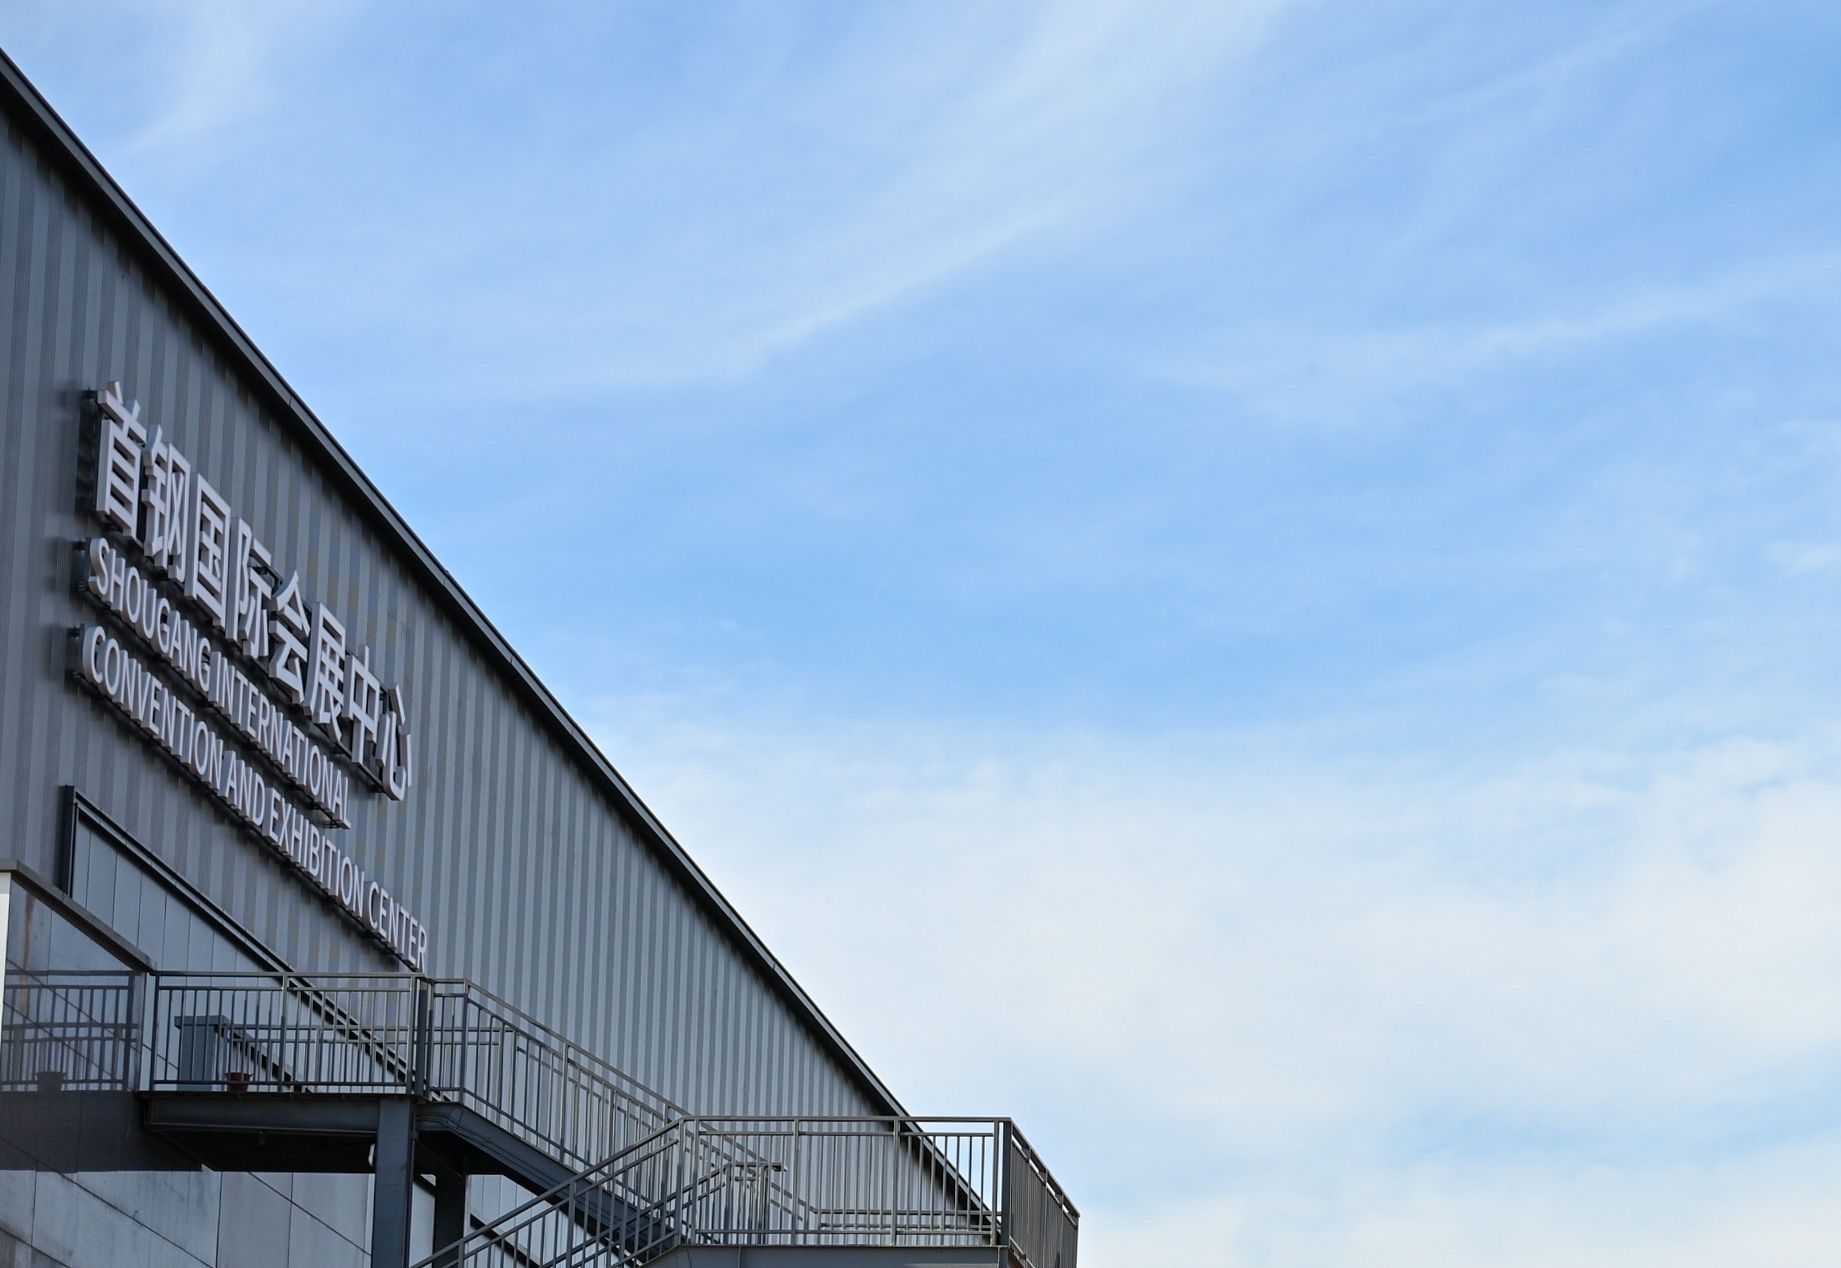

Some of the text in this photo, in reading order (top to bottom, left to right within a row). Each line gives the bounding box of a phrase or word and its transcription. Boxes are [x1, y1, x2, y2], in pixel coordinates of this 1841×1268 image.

[88, 537, 352, 831] SHOUGANG INTERNATIONAL
[96, 380, 412, 801] 首钢国际会展中心
[82, 626, 429, 973] CONVENTION AND EXHIBITION CENTER
